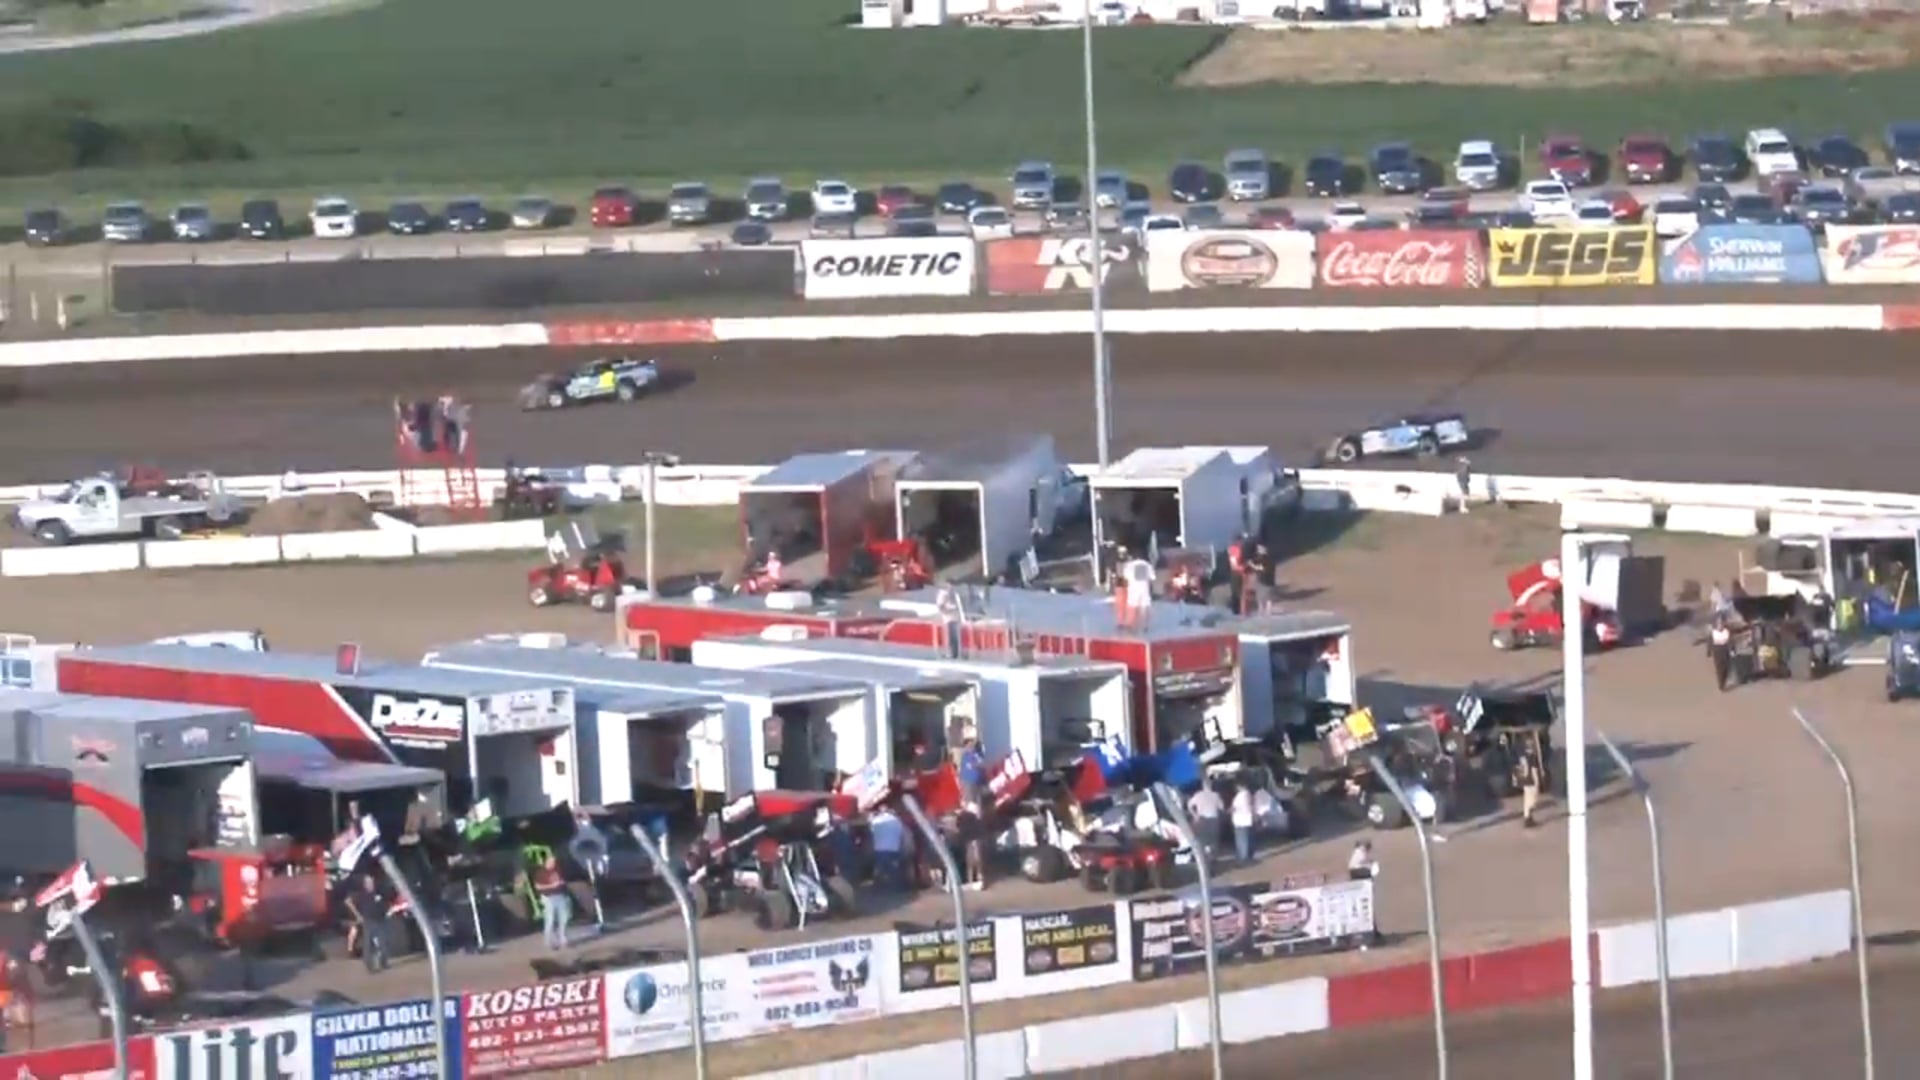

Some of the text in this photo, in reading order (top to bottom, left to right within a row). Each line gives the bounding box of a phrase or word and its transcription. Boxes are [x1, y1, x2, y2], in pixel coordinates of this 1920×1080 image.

[813, 252, 962, 277] COMETIC
[1498, 230, 1646, 277] JEGS
[1026, 931, 1050, 946] LIVE
[467, 979, 599, 1017] KOSISKI
[315, 1001, 457, 1036] SILVER DOLLR
[469, 1004, 599, 1033] AUTO PARTS
